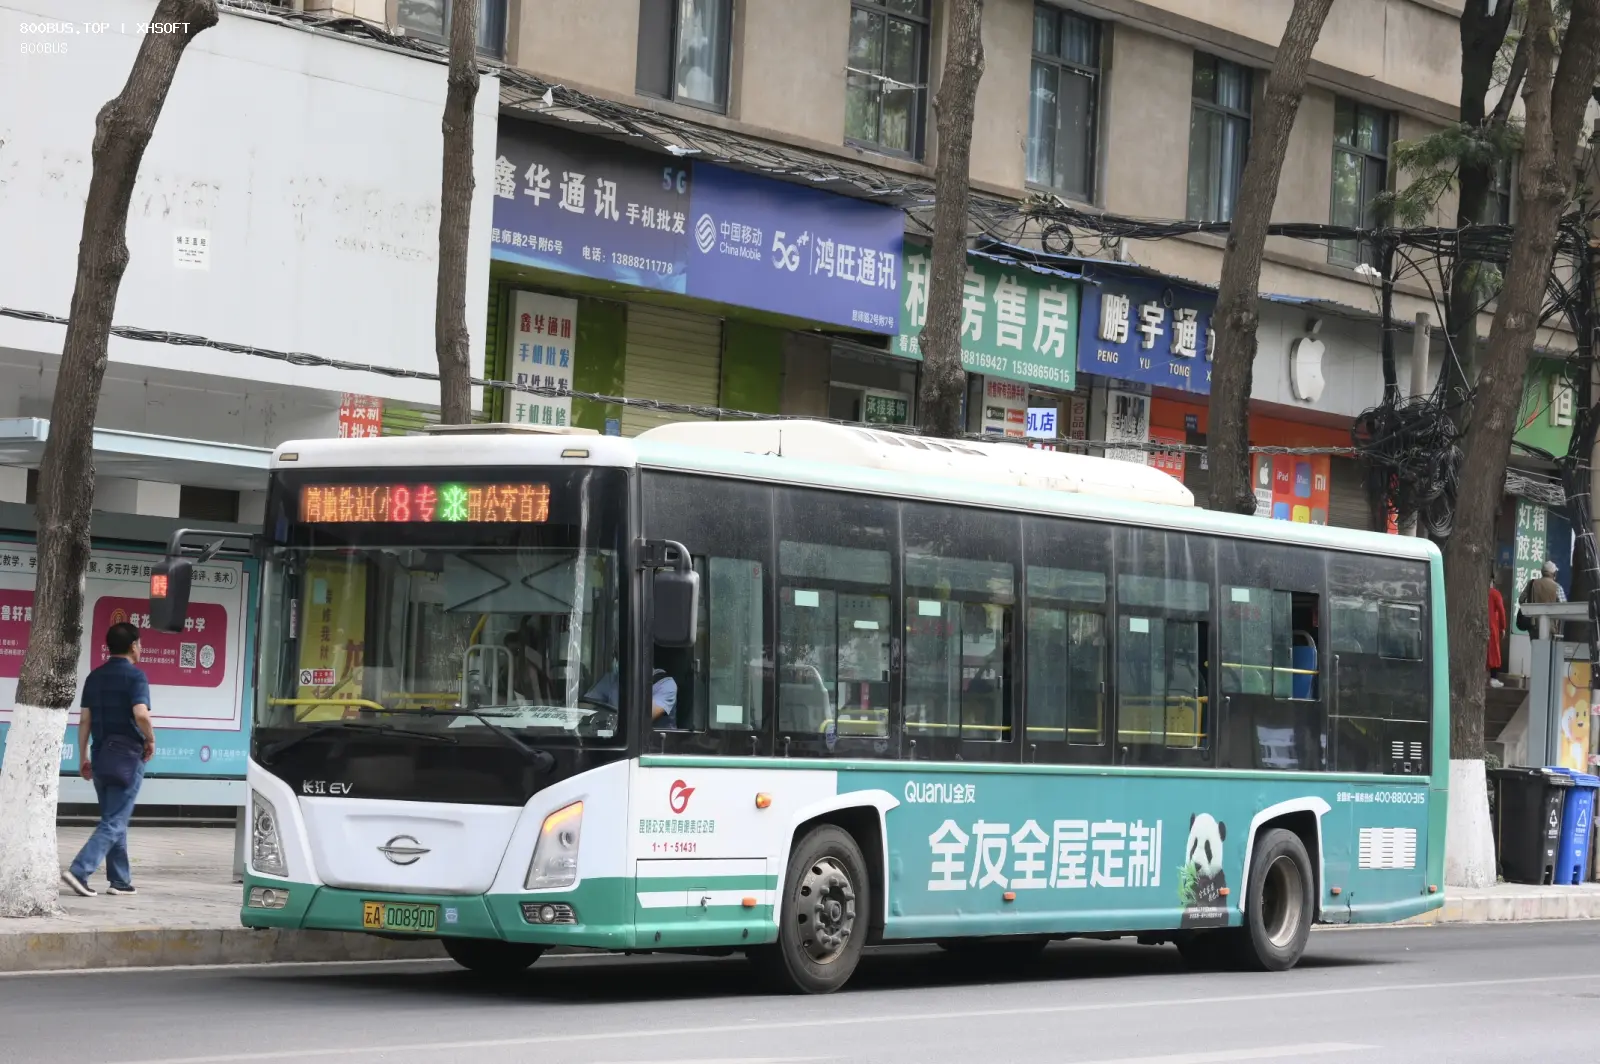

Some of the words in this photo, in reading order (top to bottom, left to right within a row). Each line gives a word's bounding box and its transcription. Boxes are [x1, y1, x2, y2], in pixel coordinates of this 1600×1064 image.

[495, 155, 619, 221] 鑫华通讯
[662, 167, 687, 194] 5G
[626, 202, 686, 235] 手机批发
[719, 220, 763, 246] 中国移动
[611, 252, 673, 274] 13888211778
[719, 242, 740, 257] China
[739, 246, 762, 261] Mobile
[814, 237, 896, 290] 鸿旺通讯
[520, 312, 572, 339] 鑫华通讯
[1098, 293, 1216, 362] 鹏宇通
[518, 342, 570, 368] 手机批发
[1097, 349, 1119, 364] PENG
[1139, 357, 1151, 370] YU
[1169, 363, 1191, 378] TONG
[1012, 360, 1070, 384] 15398650515
[1277, 471, 1289, 482] iPad
[1519, 503, 1545, 532] 灯箱
[184, 617, 206, 632] 中学
[329, 782, 354, 794] EV
[927, 819, 1163, 891] 全友全屋定制
